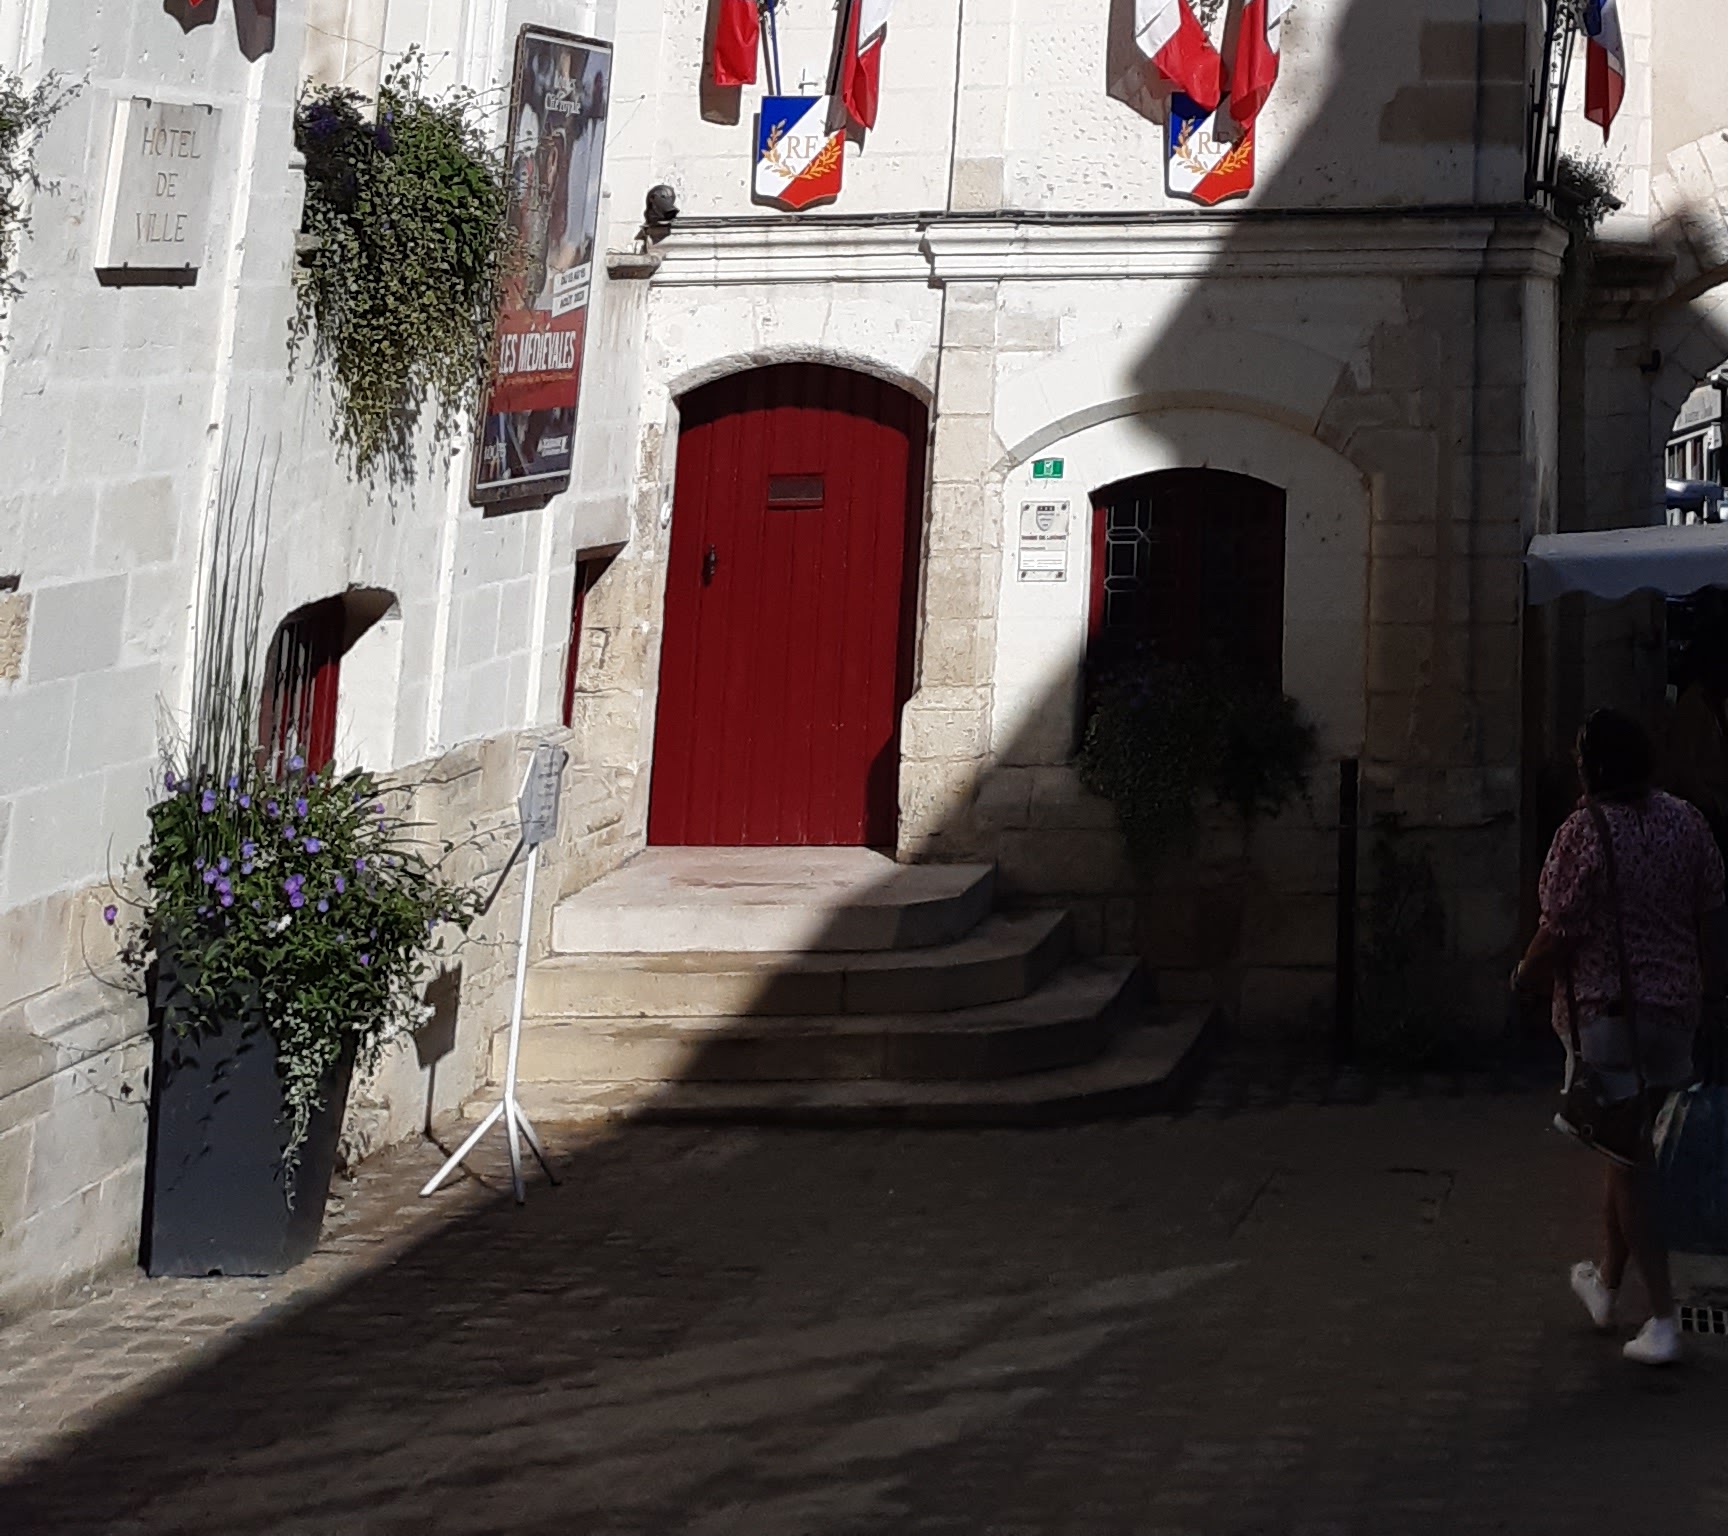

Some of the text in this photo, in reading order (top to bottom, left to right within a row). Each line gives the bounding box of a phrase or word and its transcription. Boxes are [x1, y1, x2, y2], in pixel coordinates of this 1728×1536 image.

[786, 135, 818, 159] RF
[1198, 131, 1229, 155] RF
[156, 172, 178, 198] DE
[136, 212, 188, 243] VILLE
[499, 322, 576, 374] LES MÉDIÉVALES
